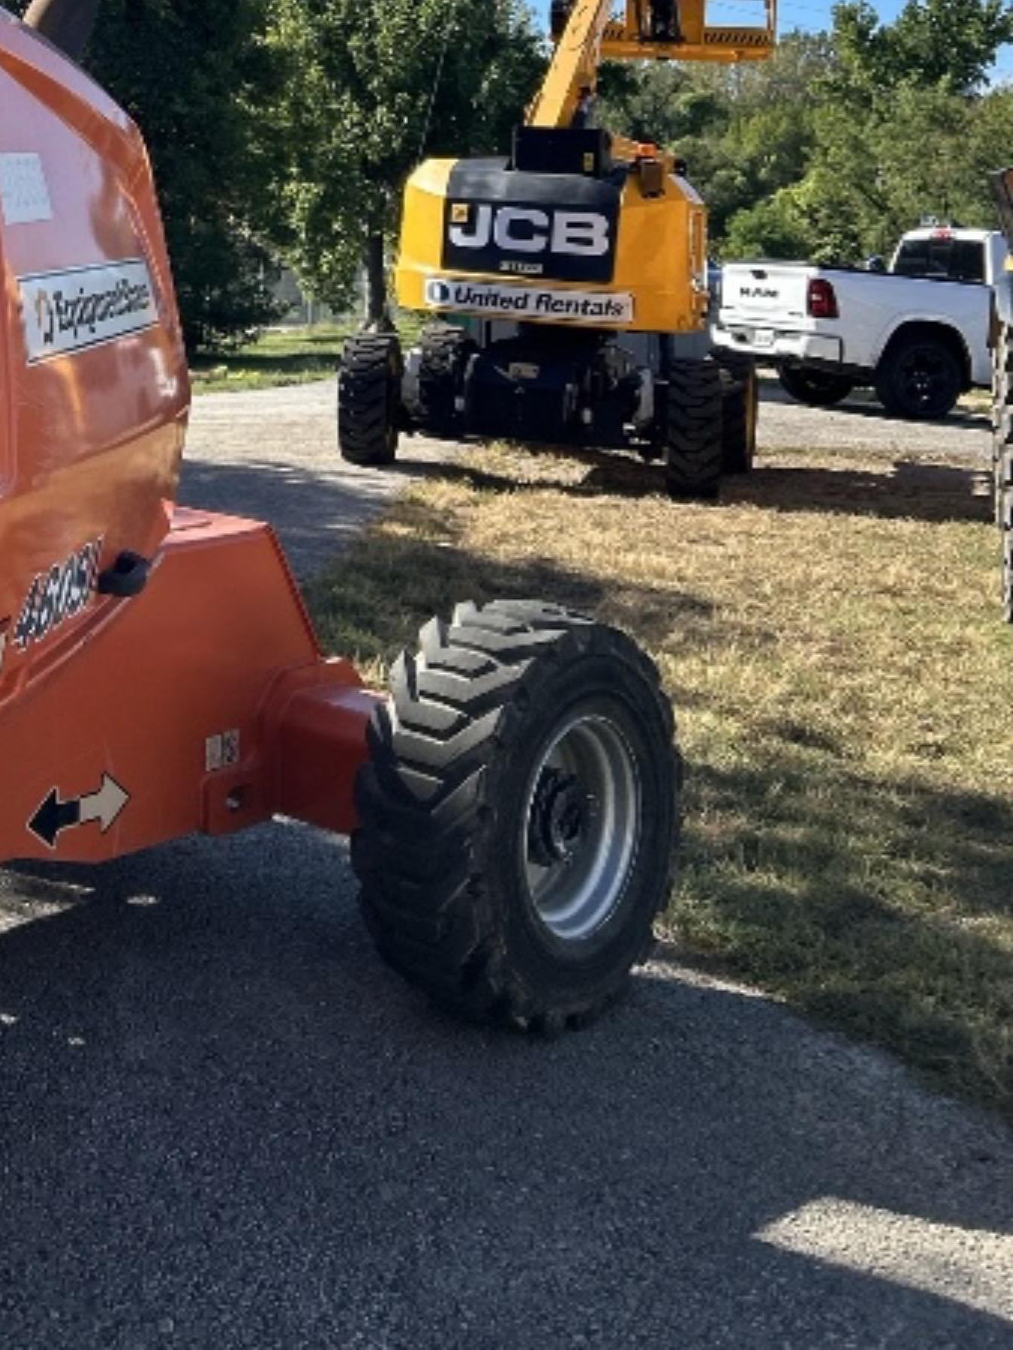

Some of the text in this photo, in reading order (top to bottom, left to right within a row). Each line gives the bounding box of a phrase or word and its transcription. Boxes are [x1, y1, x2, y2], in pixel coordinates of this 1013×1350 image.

[448, 203, 609, 256] JCB
[454, 285, 624, 318] United Rentals
